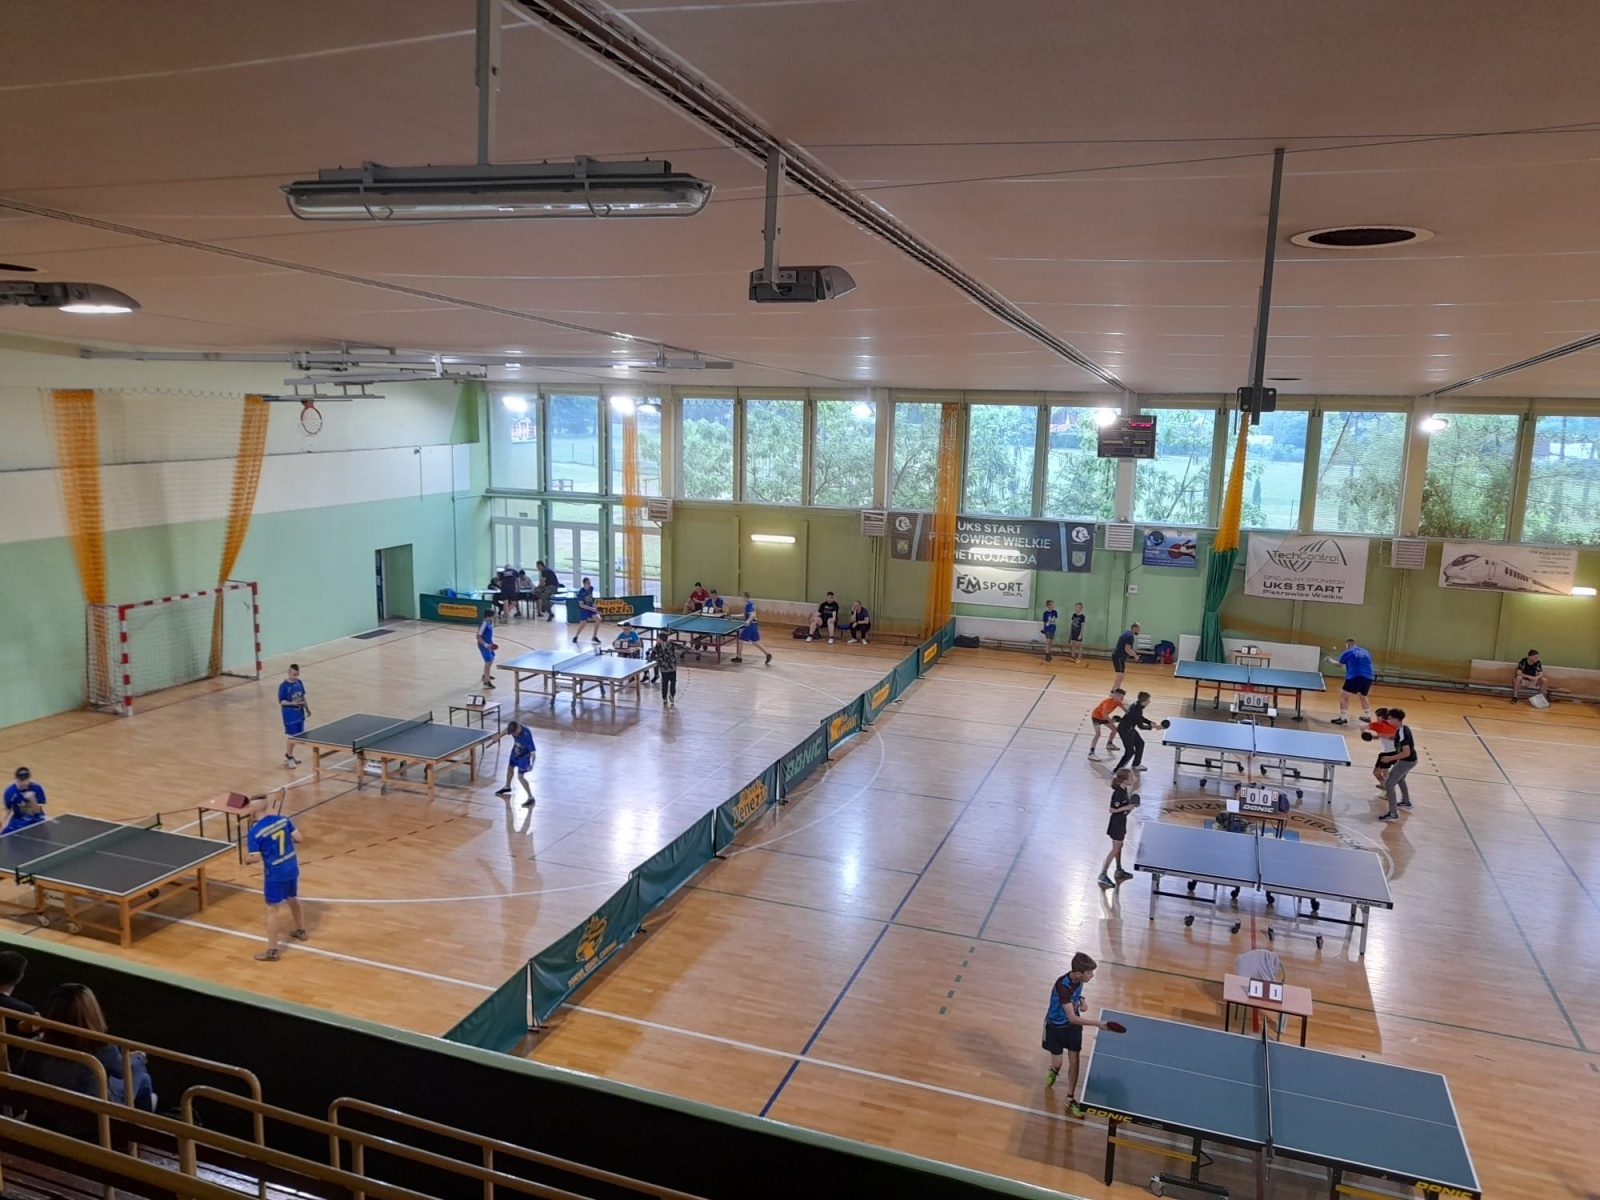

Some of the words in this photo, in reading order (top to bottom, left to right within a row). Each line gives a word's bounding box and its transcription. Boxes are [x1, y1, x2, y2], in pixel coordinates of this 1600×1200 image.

[957, 521, 981, 532] UKS
[984, 524, 1022, 534] START
[1003, 536, 1051, 549] WIELKIE
[1272, 550, 1339, 561] TechControl
[1263, 581, 1293, 590] UKS
[1296, 583, 1344, 593] START
[1262, 589, 1310, 598] Pietrowice
[602, 605, 634, 614] nezia
[1250, 792, 1256, 803] 0
[1263, 794, 1269, 804] 0
[1243, 804, 1275, 813] DONIC
[271, 829, 285, 856] 7
[1086, 1107, 1134, 1124] DONIC
[1414, 1180, 1474, 1200] DONIC
